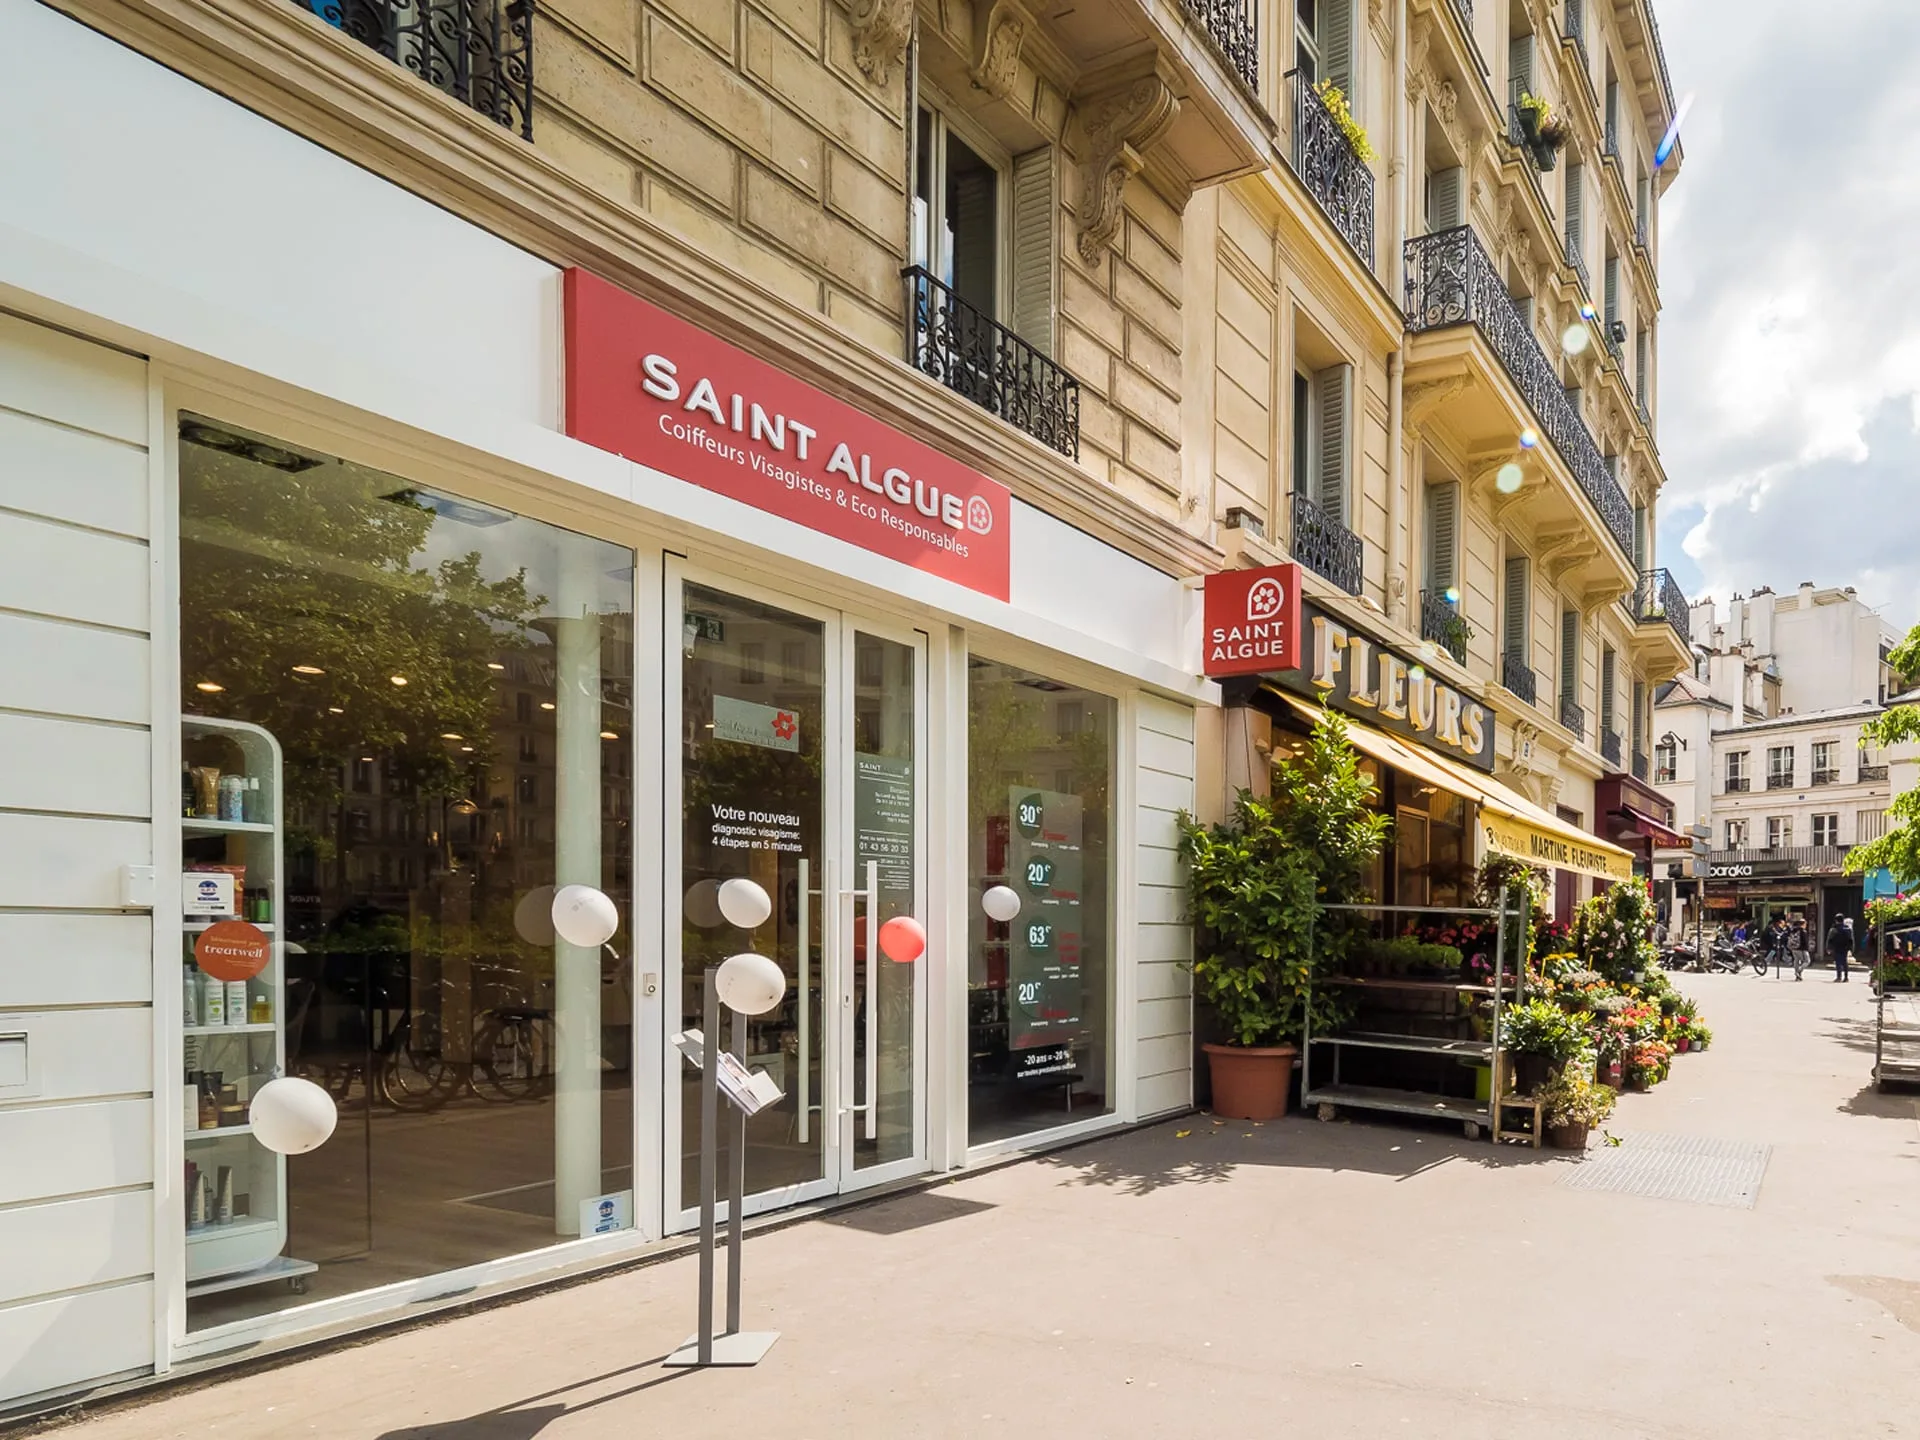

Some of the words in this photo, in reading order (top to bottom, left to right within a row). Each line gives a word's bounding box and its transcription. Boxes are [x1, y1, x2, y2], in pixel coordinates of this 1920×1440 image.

[641, 353, 817, 461] SAINT
[825, 442, 965, 531] ALGUE
[658, 414, 745, 466] Coiffeurs
[748, 448, 832, 501] Visagistes
[835, 489, 847, 508] &
[851, 494, 877, 520] Eco
[880, 511, 969, 558] Responsables
[1212, 621, 1284, 644] SAINT
[1211, 640, 1284, 661] ALGUE
[1310, 614, 1484, 755] FLEURS
[711, 803, 746, 821] Votre
[749, 811, 800, 826] nouveau
[712, 823, 757, 836] diagnostic
[712, 836, 718, 845] 4
[720, 836, 750, 849] étapes
[751, 841, 762, 849] en
[763, 840, 770, 849] 5
[771, 842, 803, 852] minutes
[1530, 833, 1568, 863] MARTINE
[1571, 847, 1607, 873] FLEURISTE
[204, 944, 263, 958] treatwell
